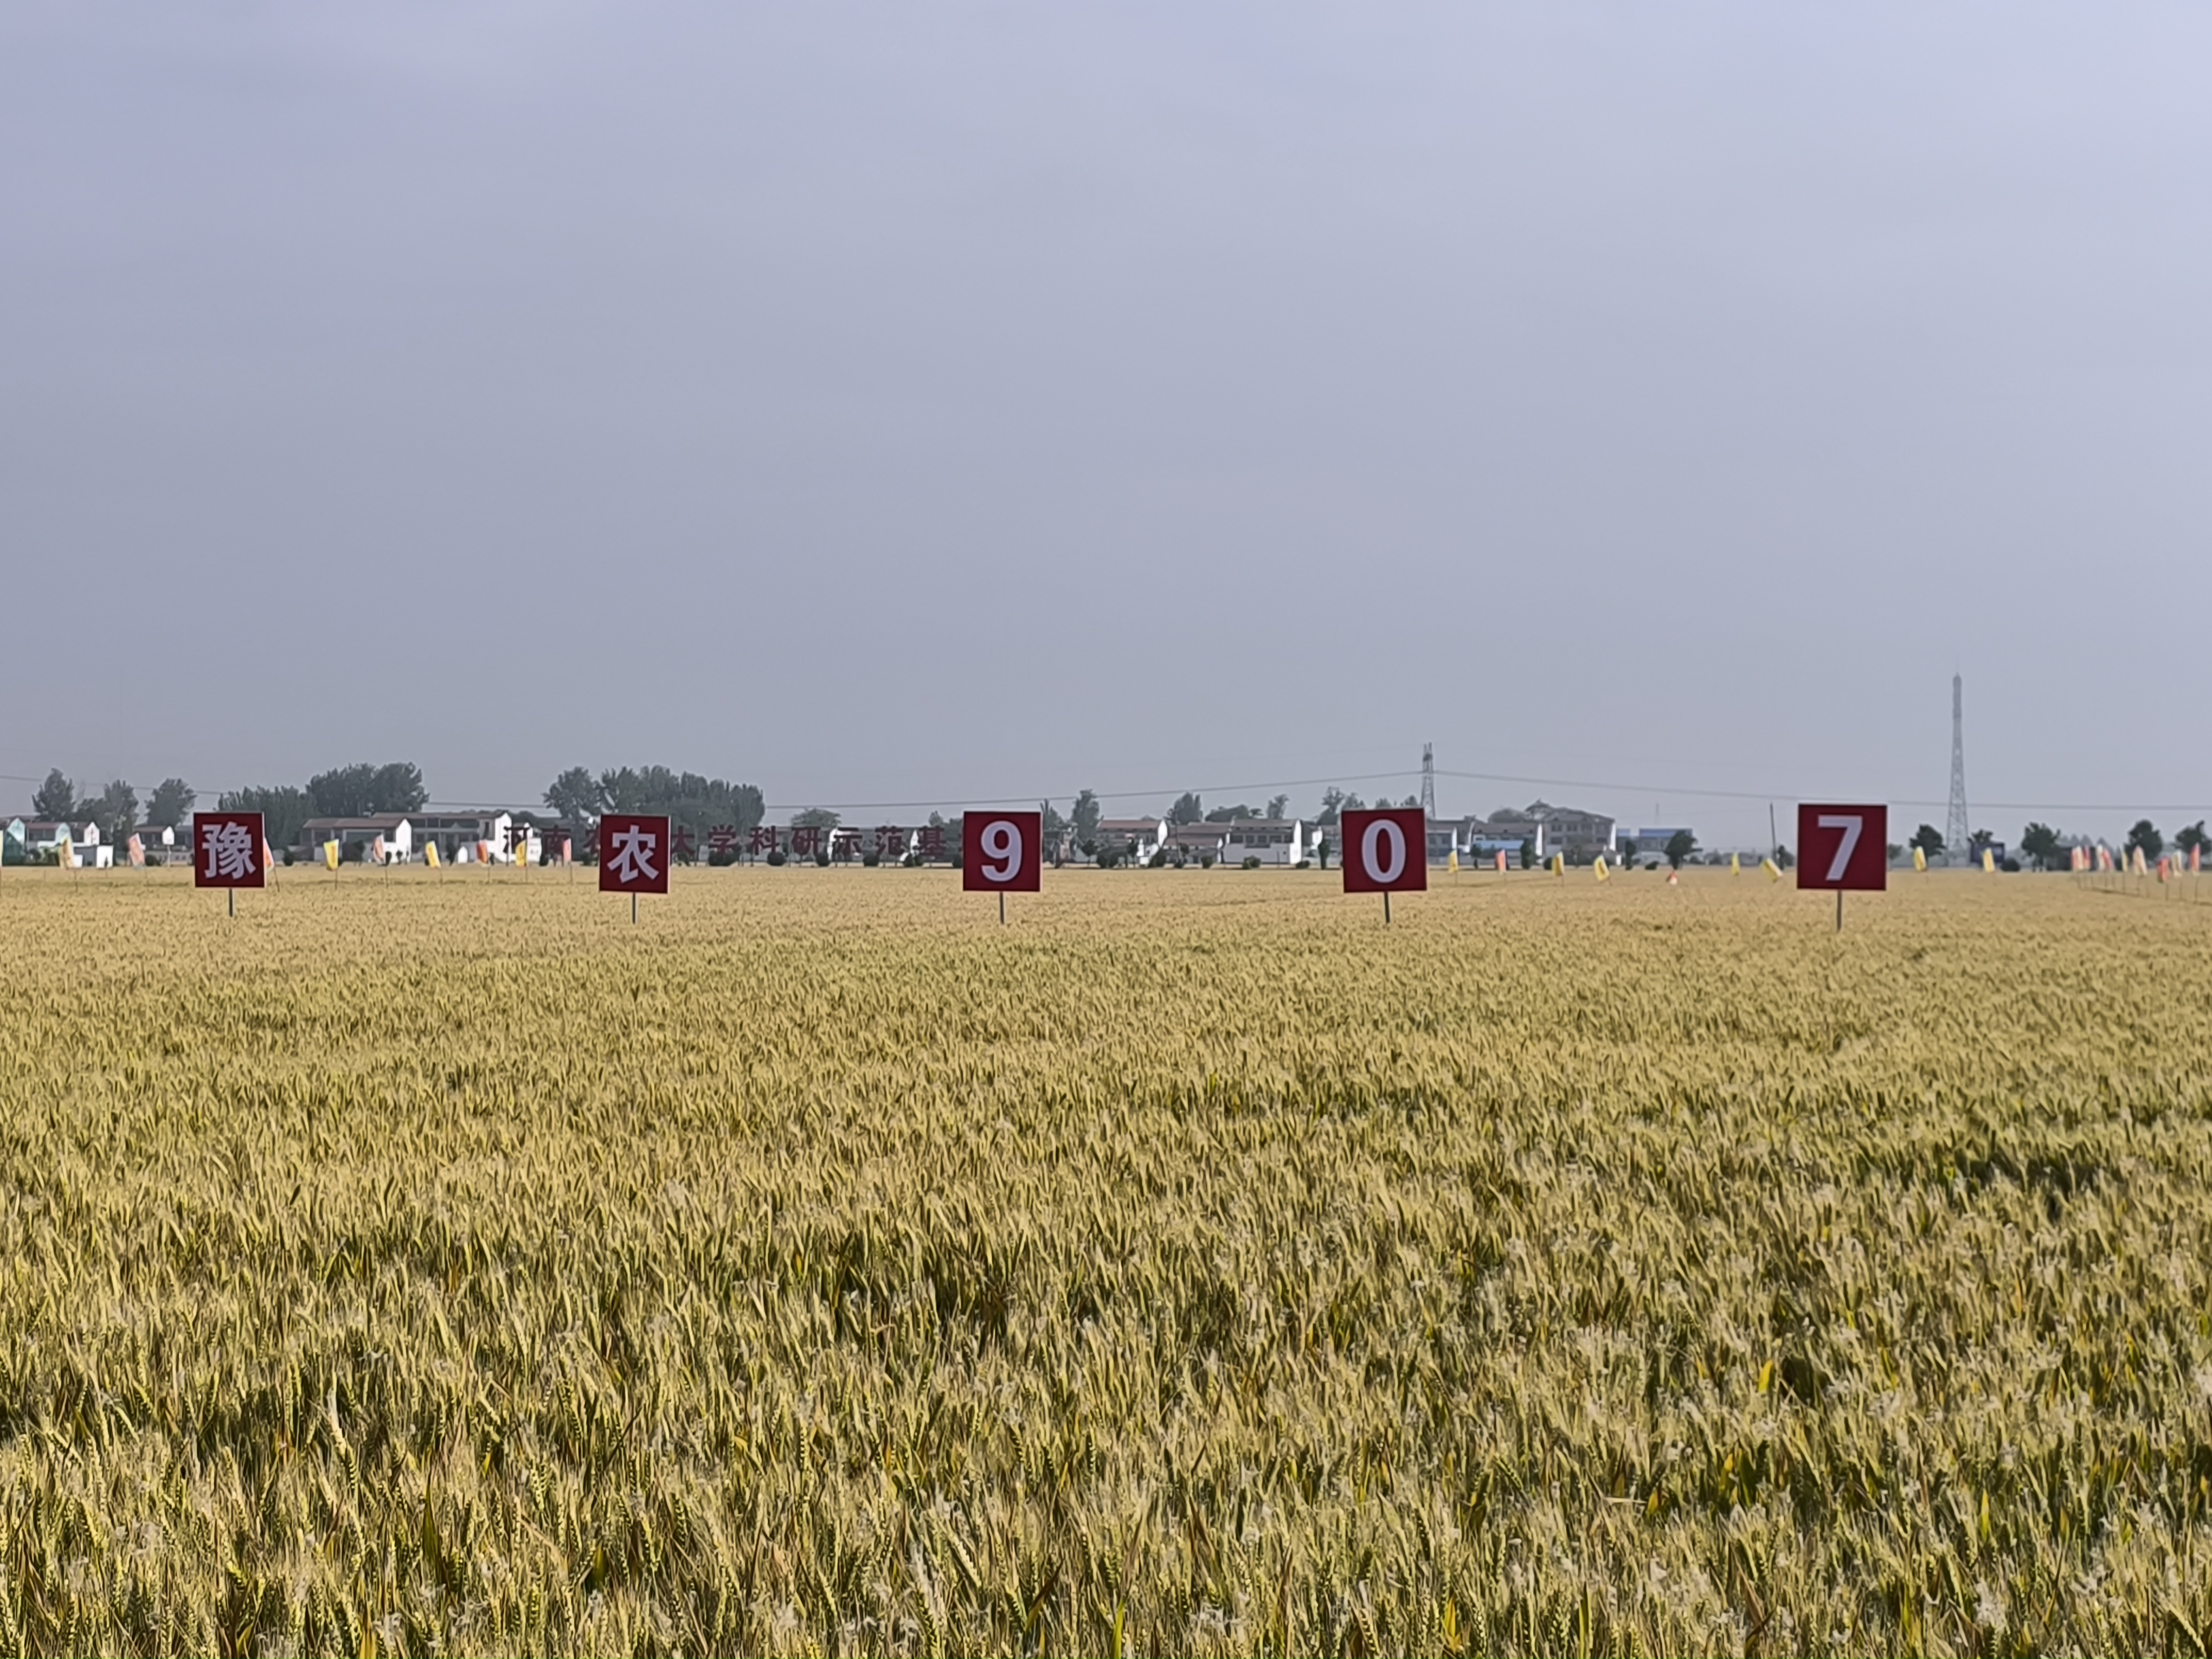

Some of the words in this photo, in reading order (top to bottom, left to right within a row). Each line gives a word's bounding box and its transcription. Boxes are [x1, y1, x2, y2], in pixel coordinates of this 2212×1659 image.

[202, 821, 256, 879] 豫
[607, 825, 659, 883] 农
[980, 820, 1023, 882] 9
[1361, 819, 1406, 883] 0
[1818, 815, 1862, 880] 7
